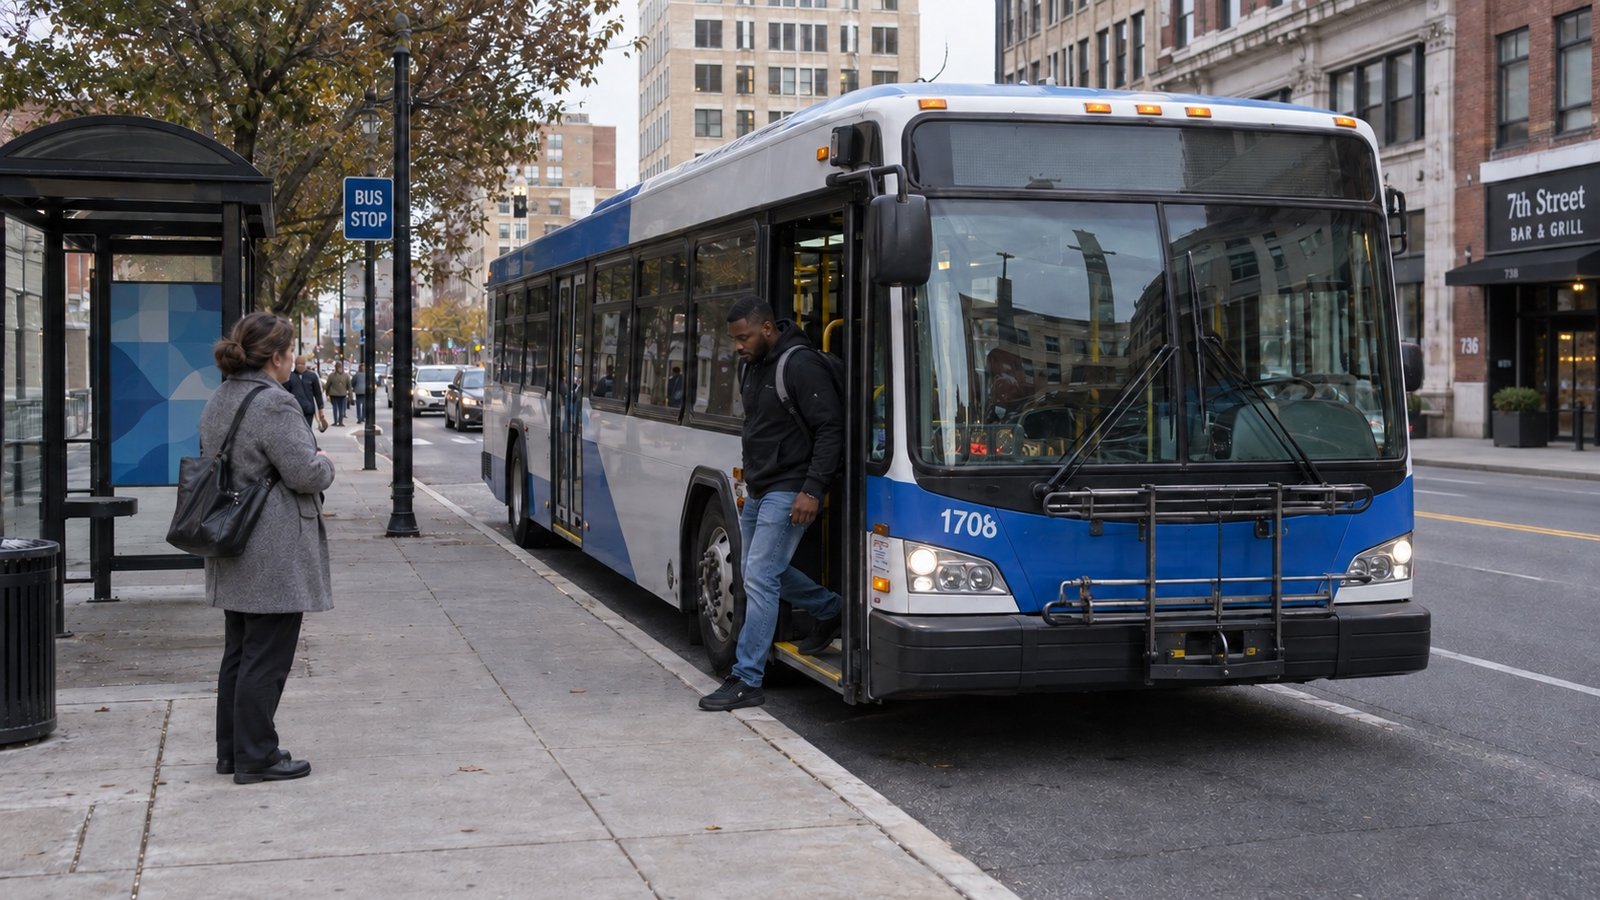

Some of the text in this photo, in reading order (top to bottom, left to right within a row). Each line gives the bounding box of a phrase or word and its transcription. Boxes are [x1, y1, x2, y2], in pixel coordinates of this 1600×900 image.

[355, 190, 383, 206] BUS
[1507, 185, 1585, 219] 7th Street
[351, 211, 387, 227] STOP
[1510, 219, 1583, 242] BAR & GRILL
[1460, 337, 1479, 354] 736
